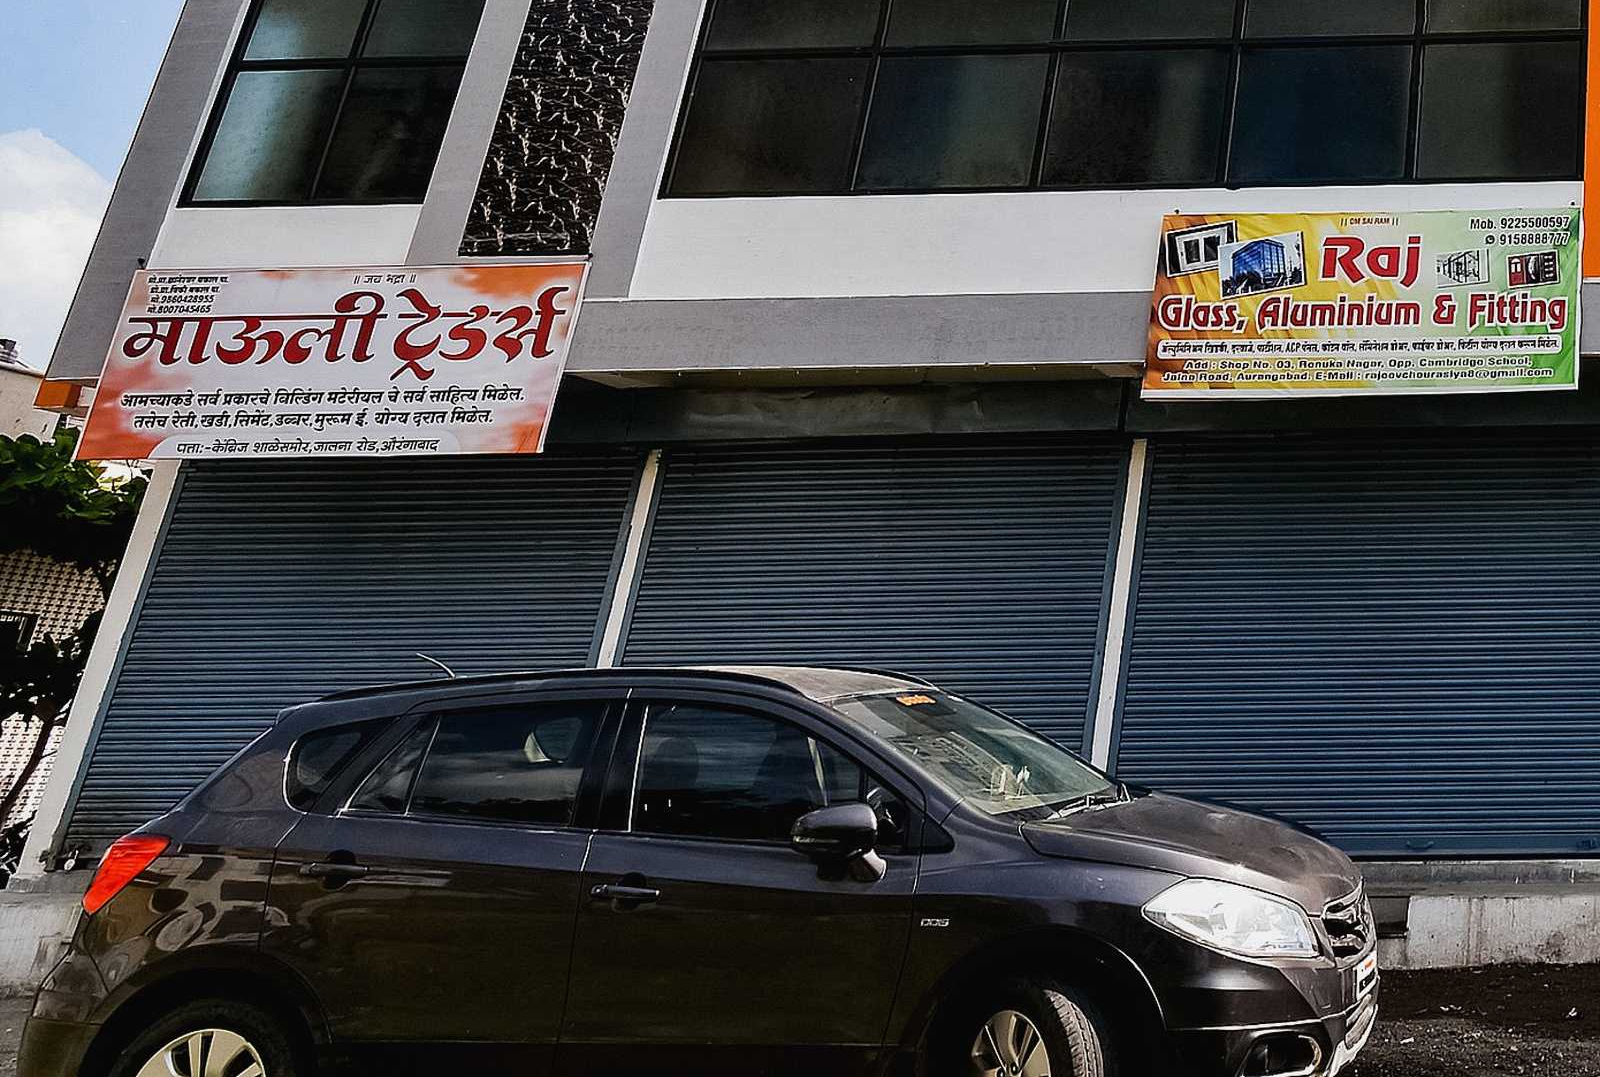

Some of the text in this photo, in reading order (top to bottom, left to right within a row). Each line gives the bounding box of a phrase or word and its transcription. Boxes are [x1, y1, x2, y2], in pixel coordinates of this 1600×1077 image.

[1470, 216, 1570, 230] Mob. 9225500597
[1499, 232, 1570, 245] 9158888777
[1321, 235, 1421, 288] Raj
[1160, 292, 1567, 332] Glass, Aluminium & Fitting
[122, 285, 570, 381] माऊली ट्रेडर्स
[1220, 361, 1249, 370] Shop
[1253, 361, 1272, 369] No.
[197, 389, 223, 407] सर्व
[222, 388, 272, 406] प्रकारचे
[387, 386, 401, 403] चे
[403, 385, 428, 403] सर्व
[429, 384, 479, 405] साहित्य
[481, 383, 525, 402] मिळेल.
[133, 411, 168, 428] तसेच
[375, 407, 411, 425] योग्य
[412, 410, 448, 427] दरात
[450, 406, 494, 423] मिळेल.
